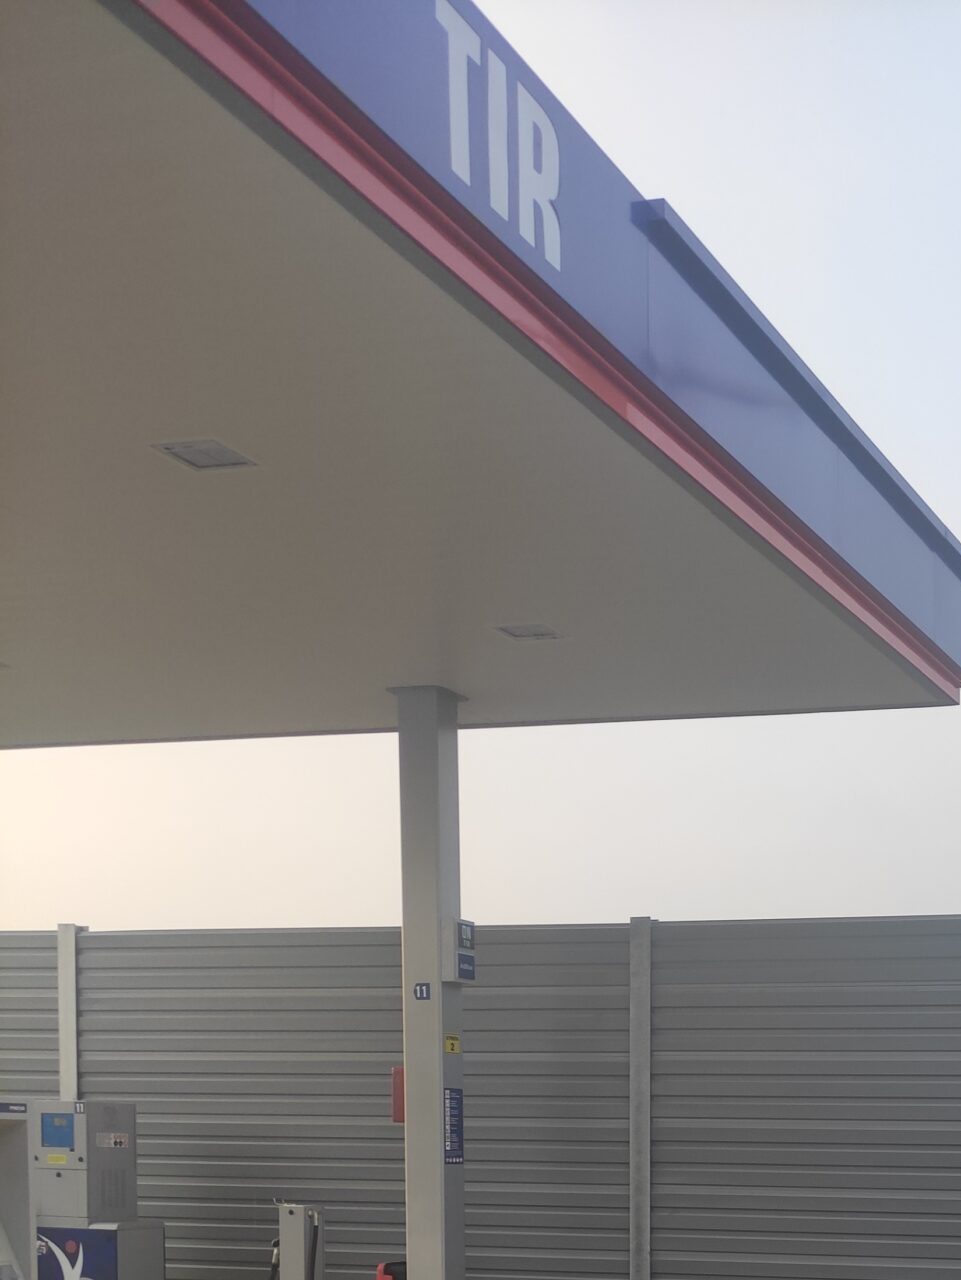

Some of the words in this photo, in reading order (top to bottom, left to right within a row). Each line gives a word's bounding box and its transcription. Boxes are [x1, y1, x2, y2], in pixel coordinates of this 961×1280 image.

[435, 0, 561, 273] TIR
[415, 985, 427, 998] 11
[450, 1042, 456, 1052] 2
[75, 1103, 84, 1113] 11
